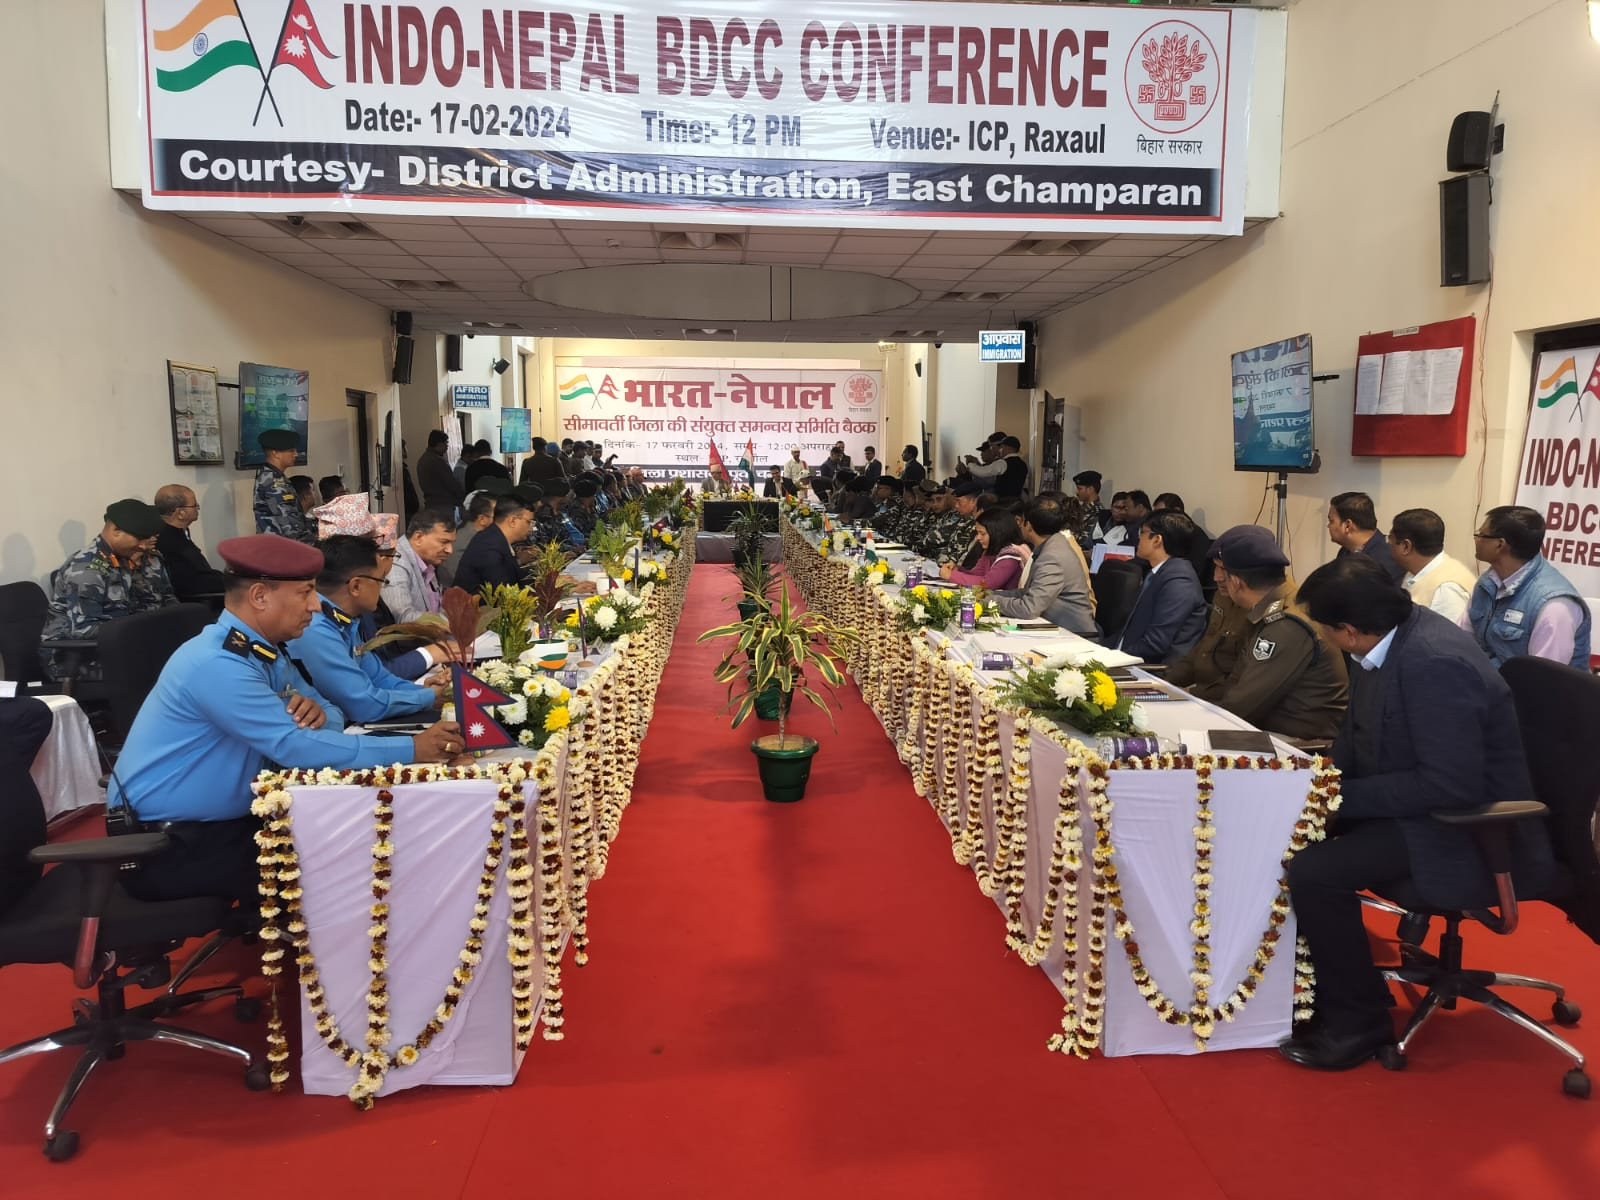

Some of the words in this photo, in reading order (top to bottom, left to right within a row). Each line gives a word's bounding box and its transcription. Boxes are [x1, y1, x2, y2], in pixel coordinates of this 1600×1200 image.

[343, 3, 640, 95] INDO-NEPAL
[656, 15, 784, 101] BDCC
[800, 20, 1109, 108] CONFERENCE
[345, 99, 422, 133] Date:-
[430, 102, 572, 138] 17-02-2024
[641, 110, 719, 146] Time:-
[727, 113, 757, 145] 12
[764, 115, 801, 147] PM
[868, 117, 961, 152] Venue:-
[967, 119, 1016, 159] ICP,
[1024, 121, 1106, 155] Raxaul
[1136, 133, 1165, 155] बिहार
[1167, 139, 1204, 155] सरकार
[179, 149, 385, 191] Courtesy-
[399, 154, 554, 191] District
[565, 161, 873, 206] Administration,
[886, 171, 976, 204] East
[985, 173, 1202, 211] Champaran
[983, 349, 1021, 359] IMMIGRATION
[624, 374, 835, 408] भारत-नेपाल
[563, 414, 626, 432] सीमावर्ती
[628, 415, 665, 432] जिला
[667, 415, 688, 433] की
[690, 415, 736, 437] संयुक्त
[738, 420, 793, 434] समन्वय
[795, 417, 841, 434] समिति
[842, 417, 878, 434] बैठक
[697, 441, 728, 451] 204,
[1525, 438, 1600, 488] INDO-N
[1545, 501, 1600, 535] BDC
[1540, 537, 1600, 567] NFERE
